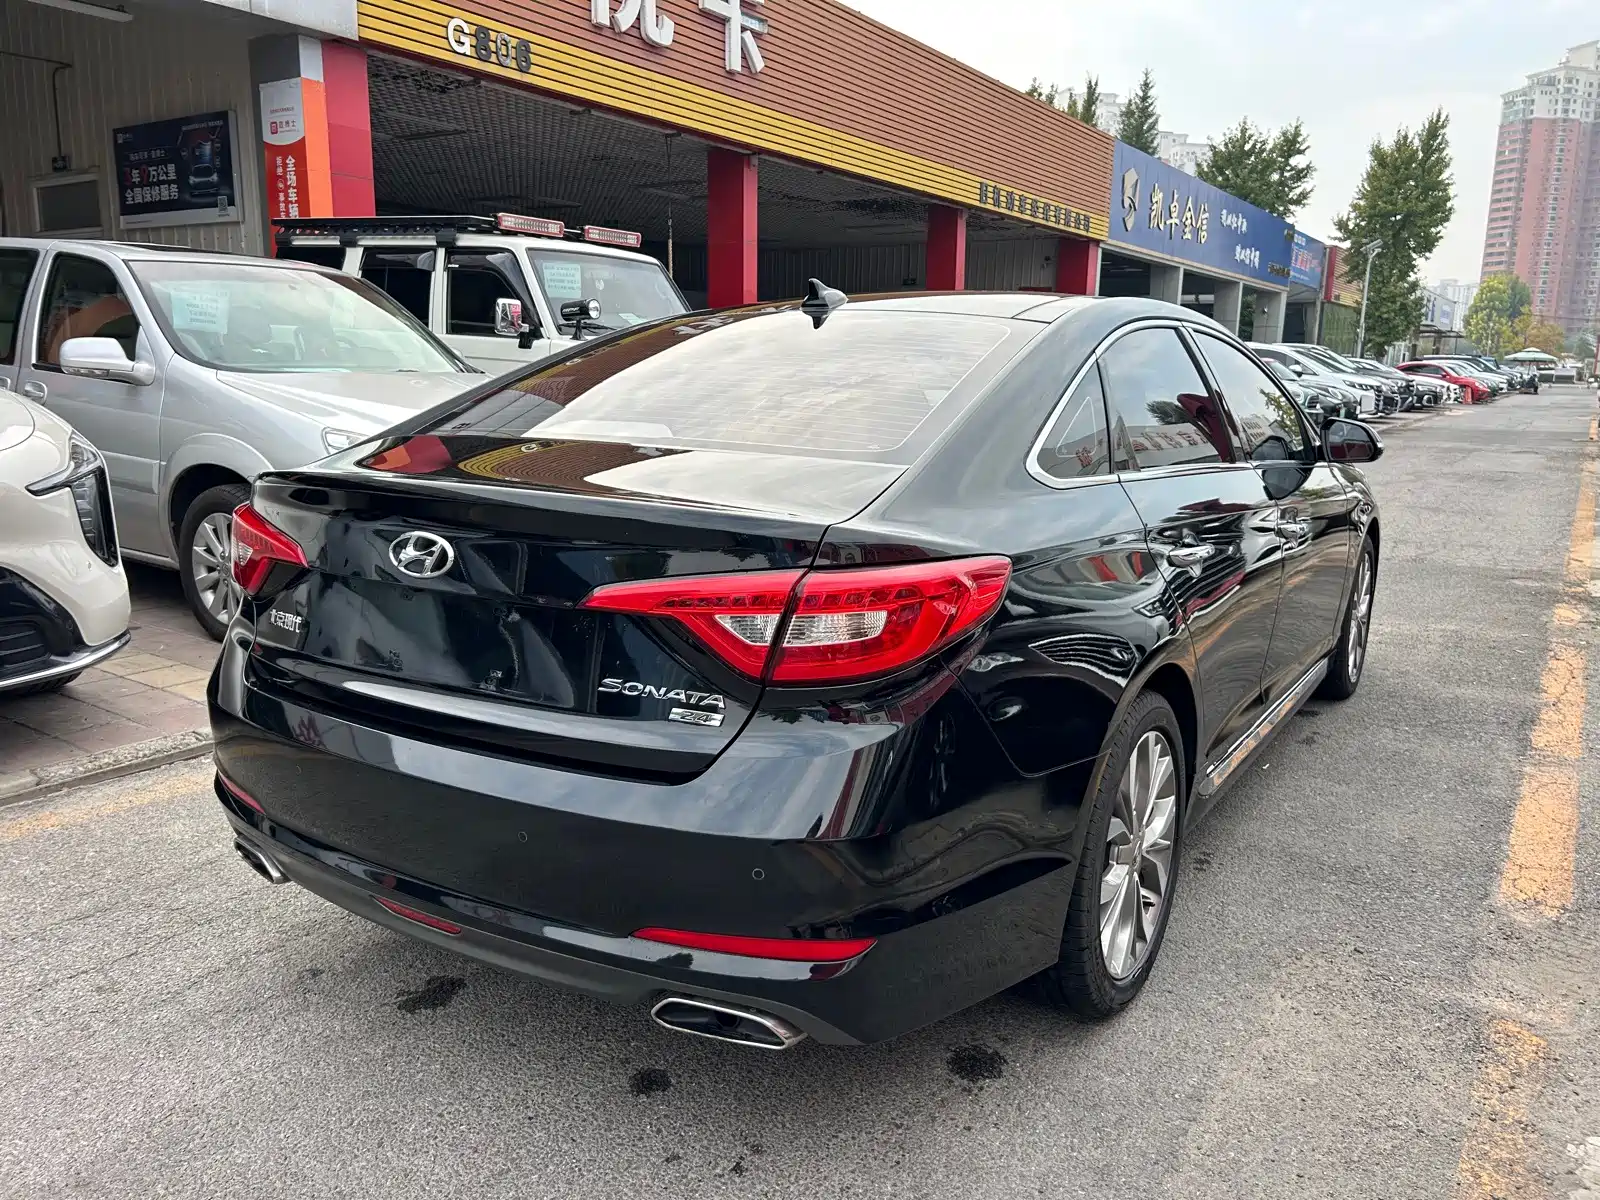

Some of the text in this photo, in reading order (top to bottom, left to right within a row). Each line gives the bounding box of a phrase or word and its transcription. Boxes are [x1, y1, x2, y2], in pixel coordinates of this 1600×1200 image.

[446, 16, 532, 73] G806
[123, 163, 177, 186] 3年9万公里
[285, 155, 299, 219] 全场车辆
[125, 183, 179, 205] 全国保修服务
[1149, 182, 1210, 244] 凯卓金信
[269, 608, 302, 633] 北京现代
[597, 677, 726, 709] SONATA
